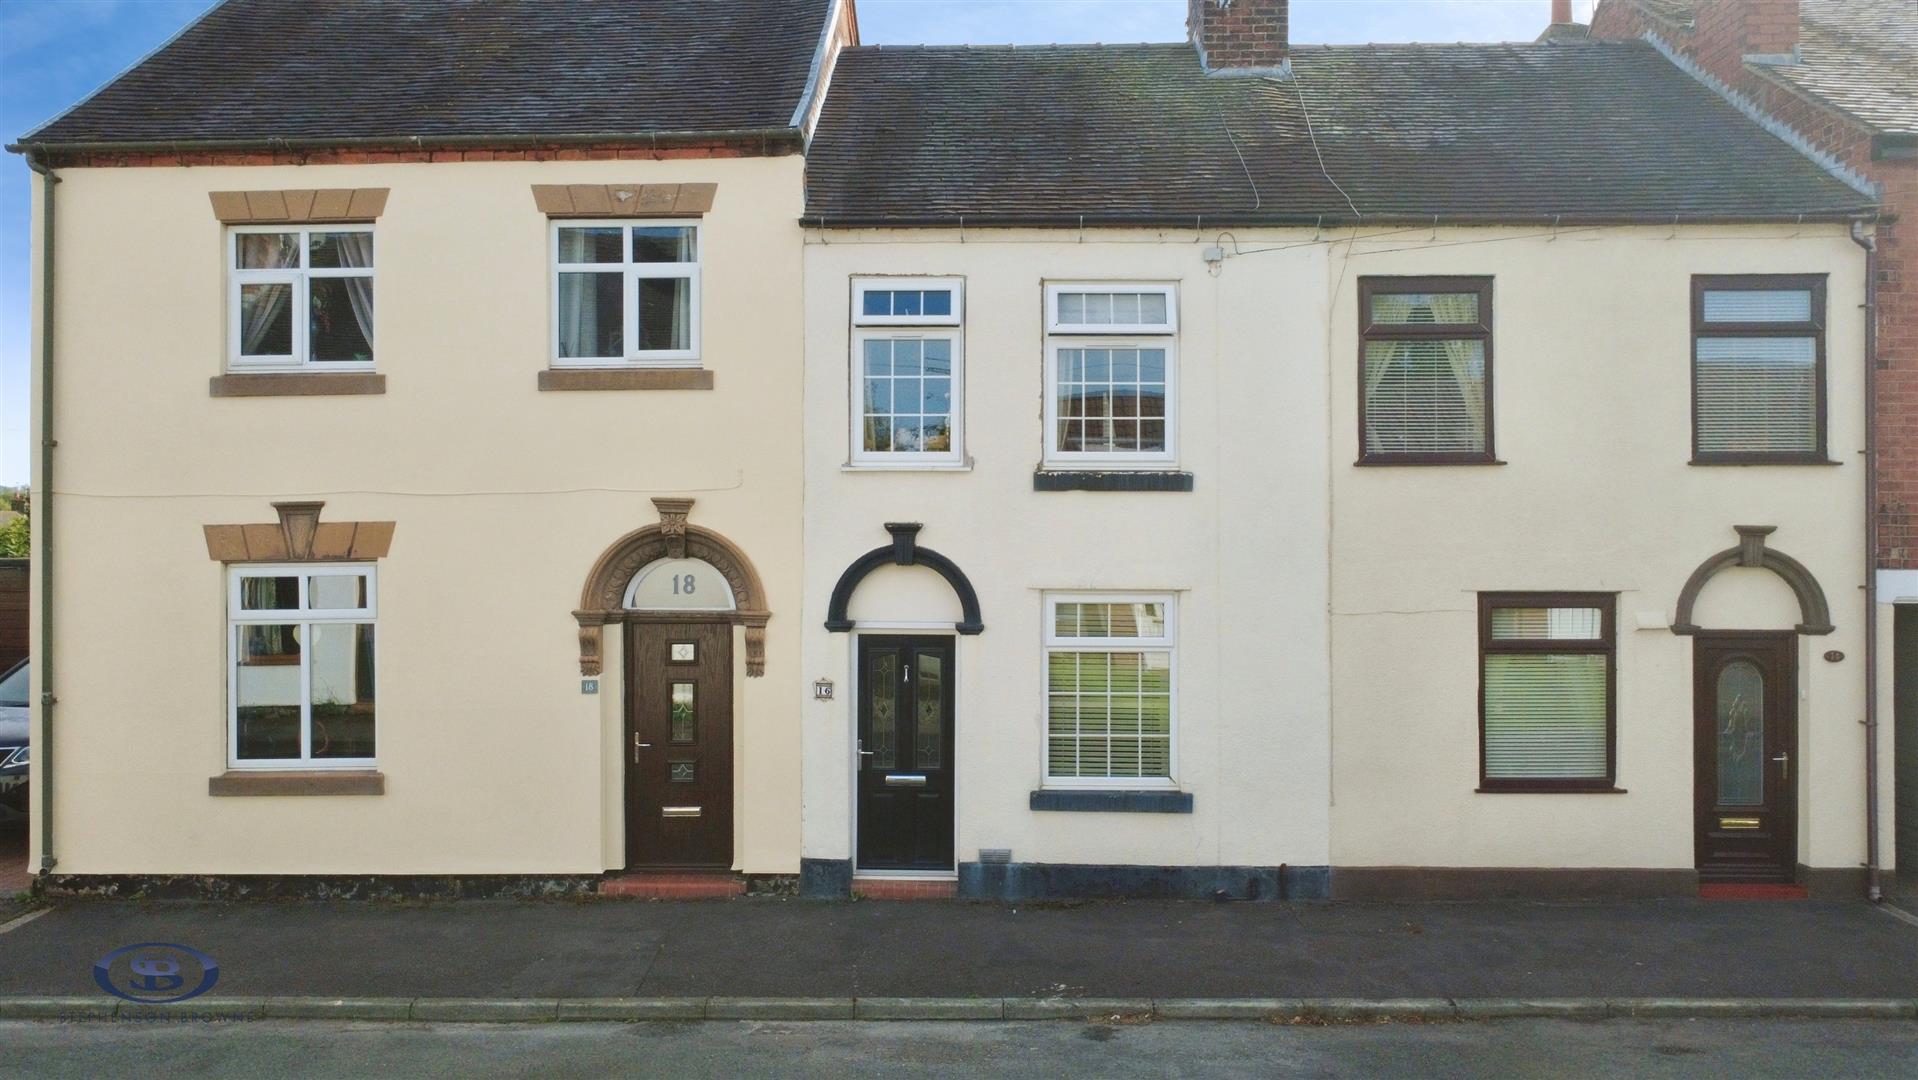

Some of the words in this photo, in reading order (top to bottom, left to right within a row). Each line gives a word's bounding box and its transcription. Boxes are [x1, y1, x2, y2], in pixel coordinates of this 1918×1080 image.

[673, 574, 696, 595] 18
[585, 682, 594, 691] 18
[819, 686, 831, 695] 16
